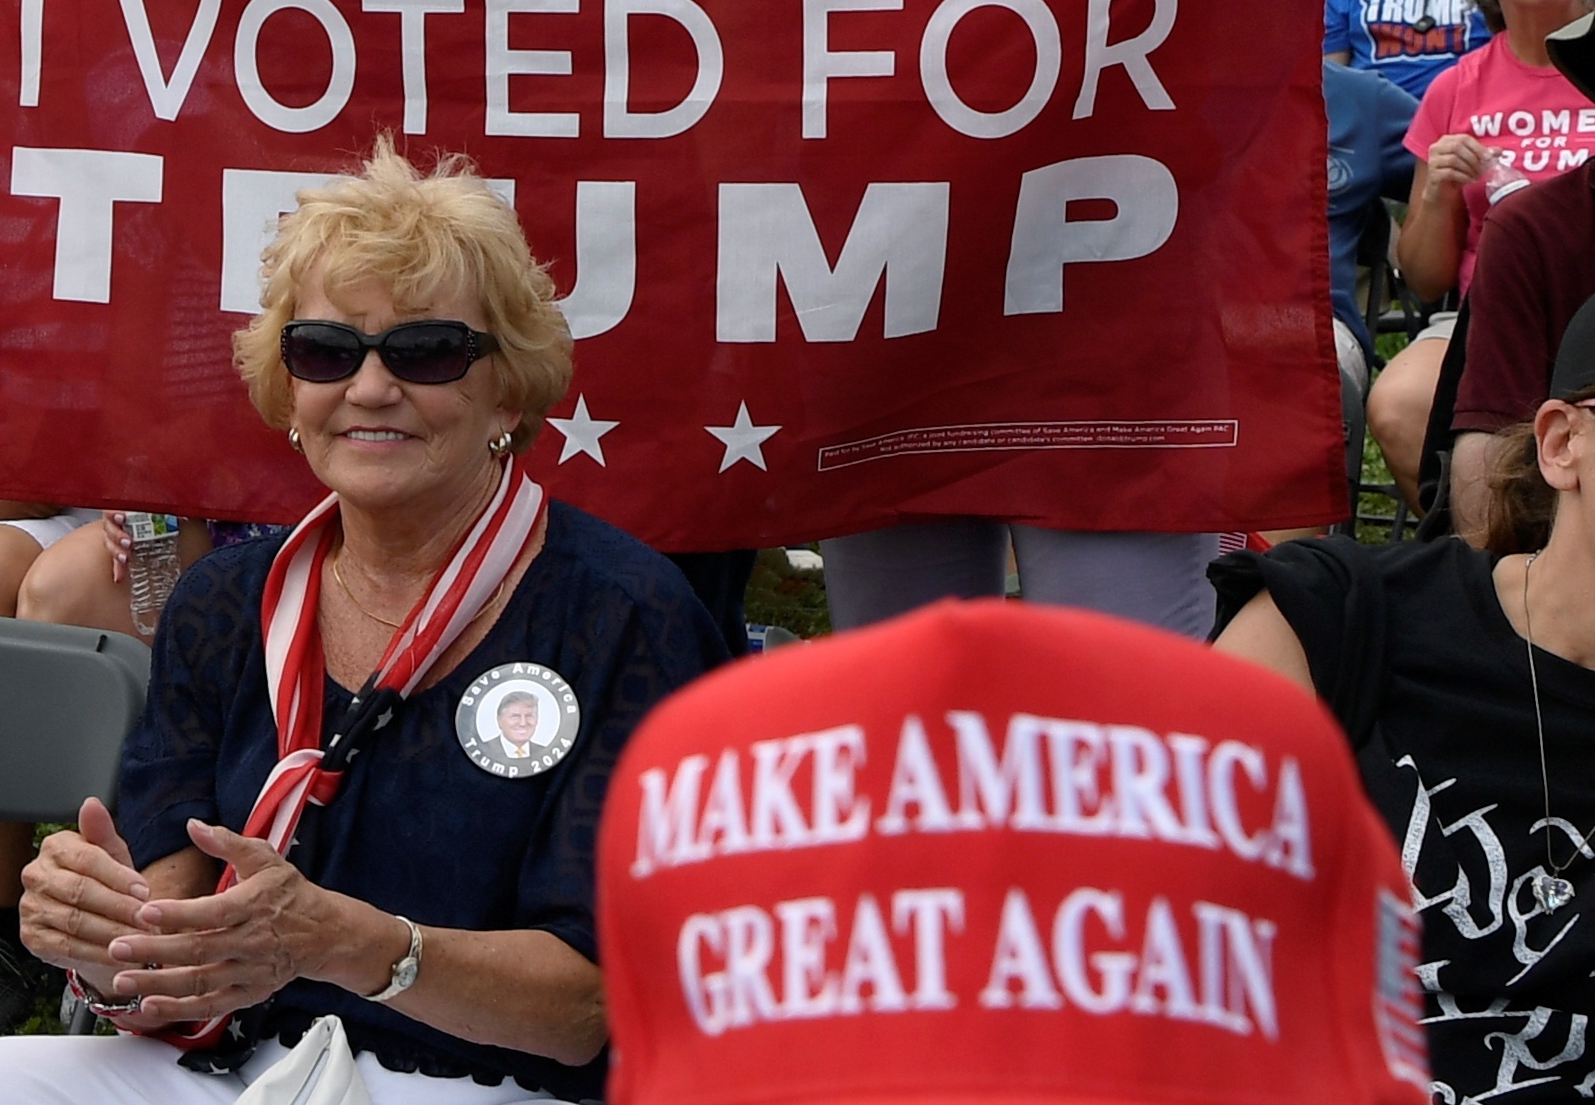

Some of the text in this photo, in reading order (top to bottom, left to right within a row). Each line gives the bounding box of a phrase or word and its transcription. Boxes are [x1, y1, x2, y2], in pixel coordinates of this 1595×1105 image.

[1498, 149, 1590, 172] RUM
[1521, 136, 1567, 148] FOR
[462, 662, 576, 714] Save America
[465, 737, 572, 778] Trump 2024
[630, 709, 1315, 882] MAKE AMERICA
[676, 887, 966, 1037] GREAT
[979, 886, 1280, 1041] AGAIN
